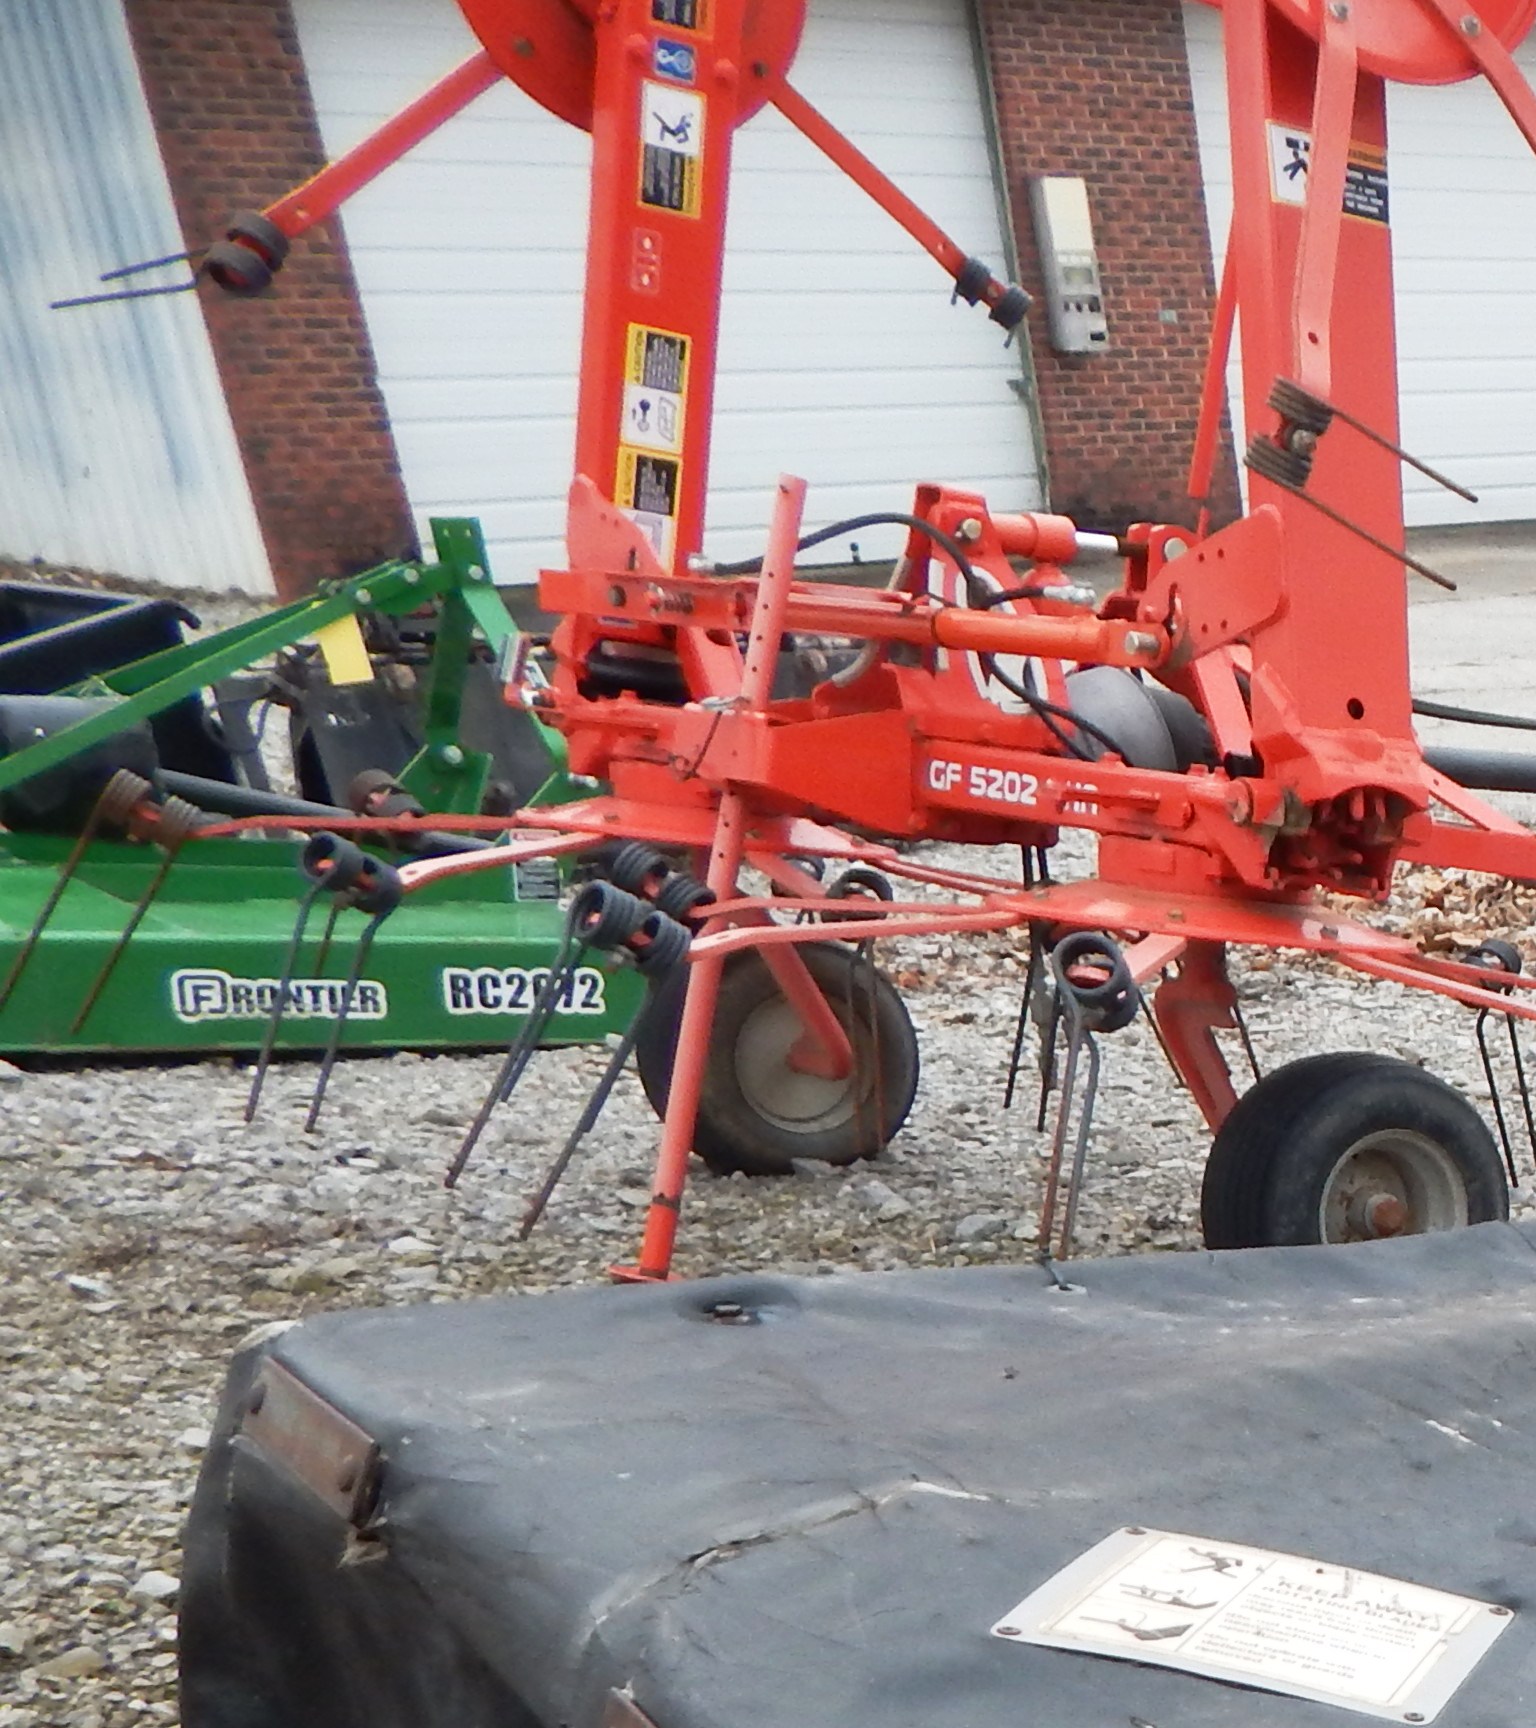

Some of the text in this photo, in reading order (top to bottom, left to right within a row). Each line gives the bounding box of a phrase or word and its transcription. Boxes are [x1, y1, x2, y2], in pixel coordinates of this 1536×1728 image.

[929, 760, 962, 791] GF
[969, 766, 1039, 805] 5202
[446, 970, 603, 1011] RC202
